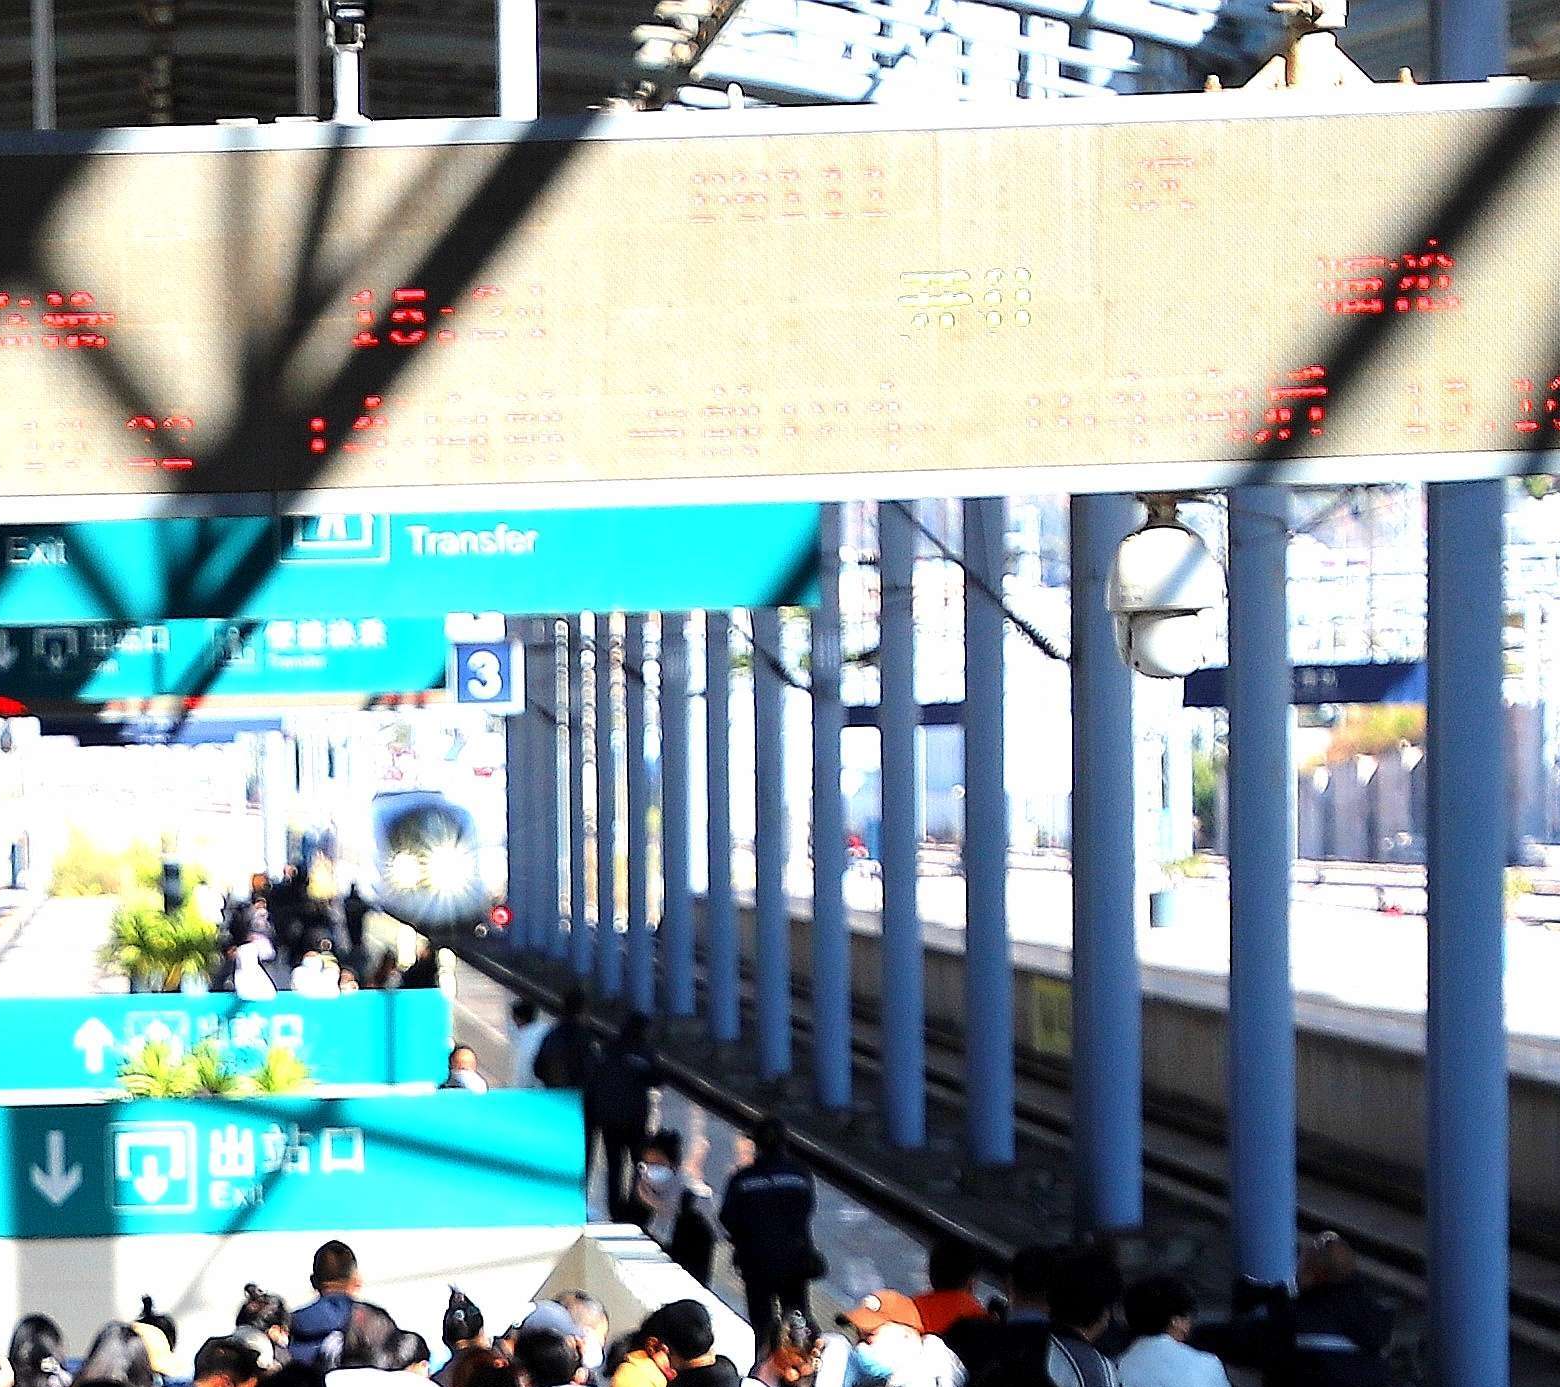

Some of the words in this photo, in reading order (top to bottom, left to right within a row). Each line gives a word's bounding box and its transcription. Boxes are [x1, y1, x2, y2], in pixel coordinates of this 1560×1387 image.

[7, 536, 68, 566] Exit
[406, 523, 539, 557] Transfer
[465, 650, 502, 700] 3
[207, 1122, 365, 1175] 出站口
